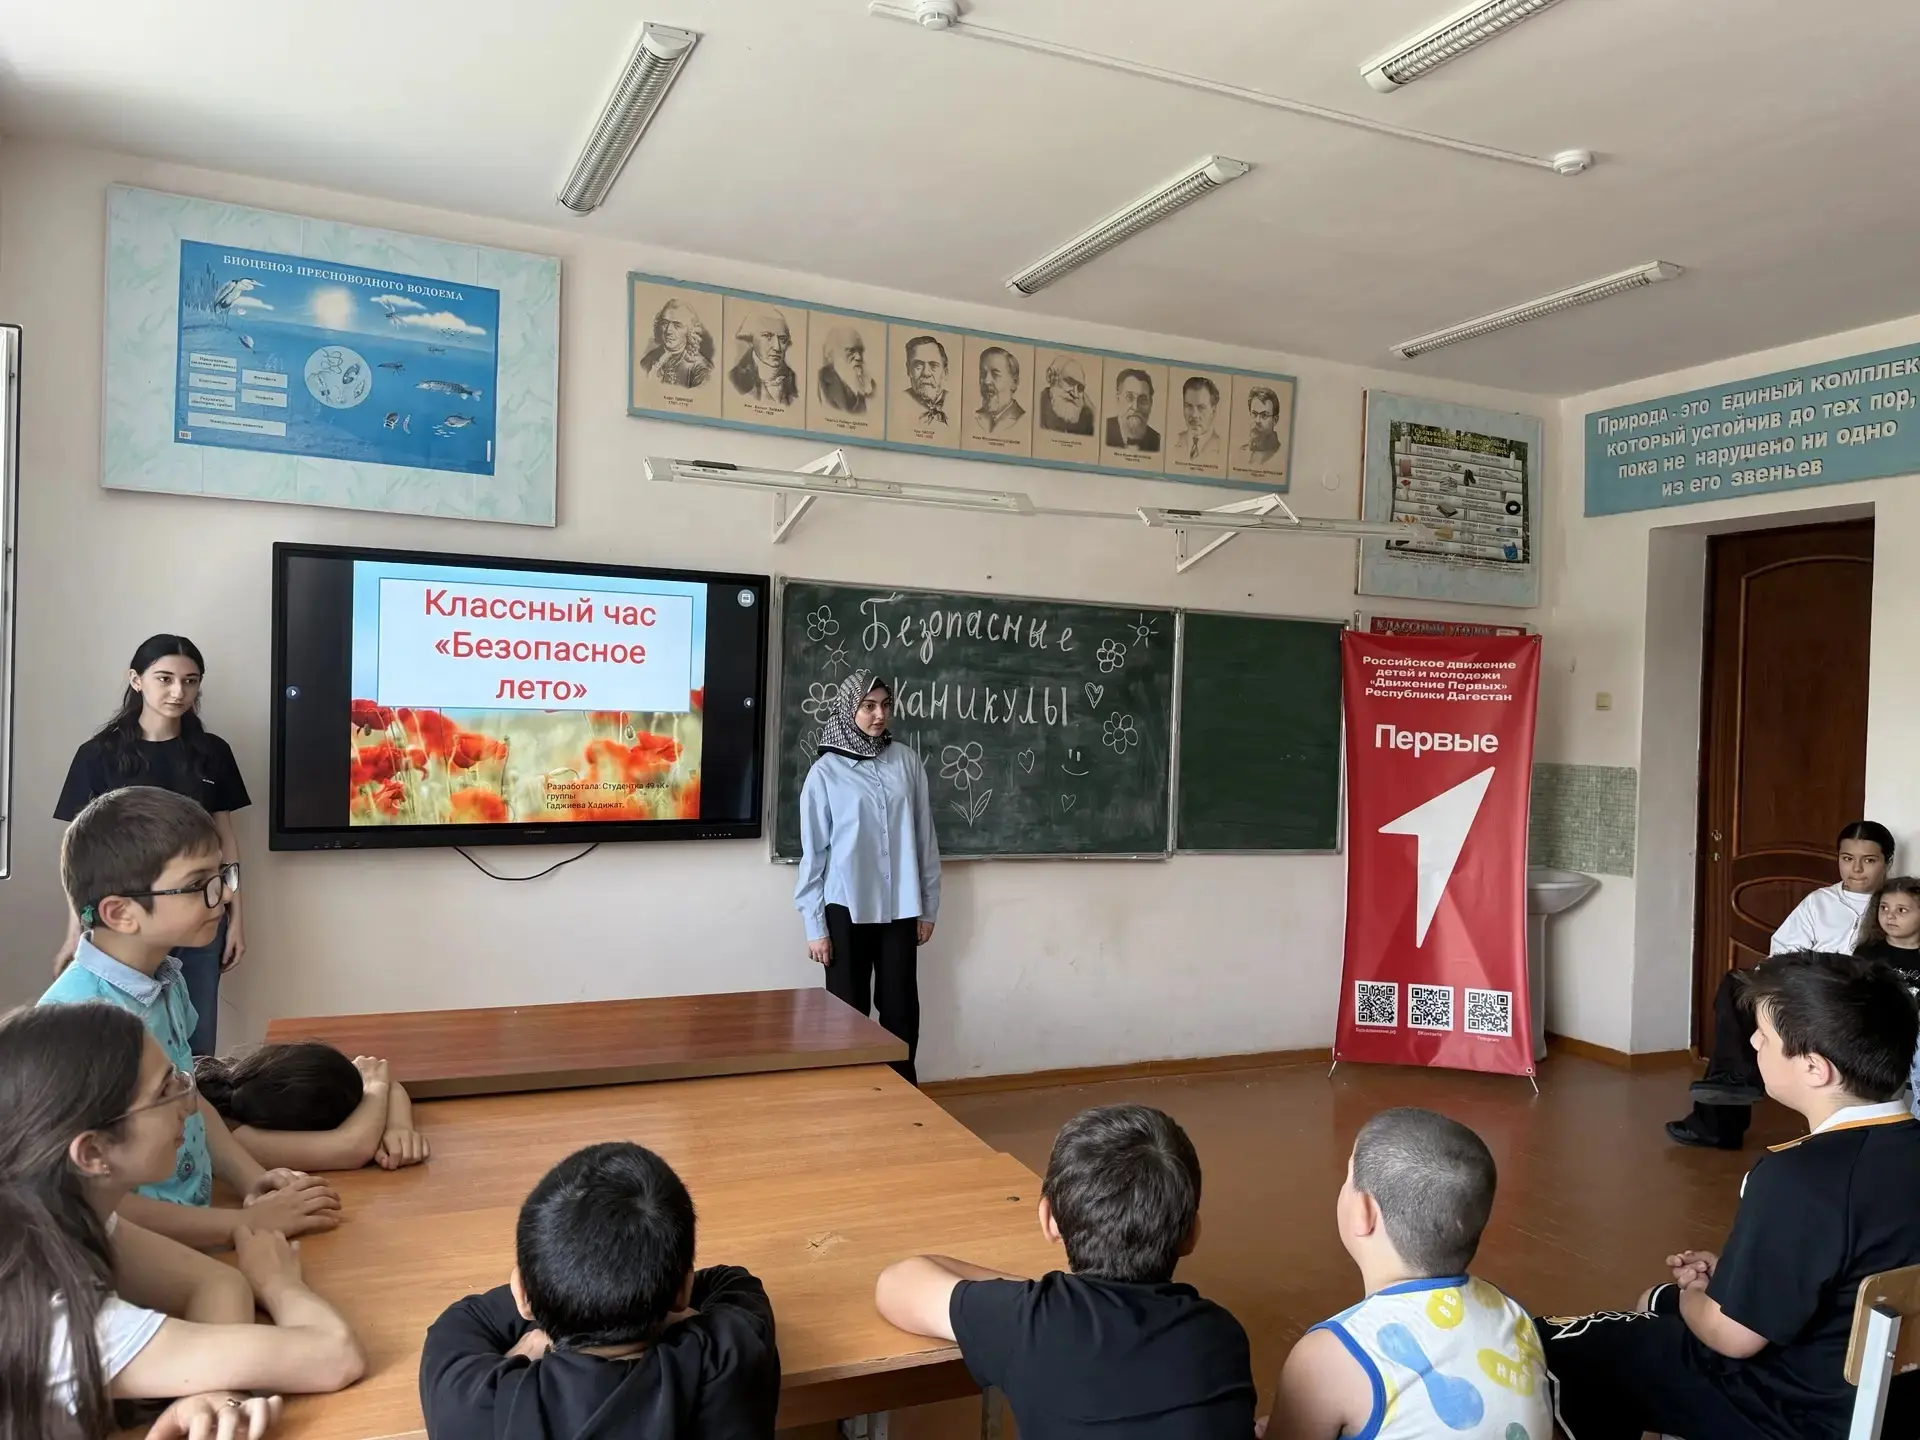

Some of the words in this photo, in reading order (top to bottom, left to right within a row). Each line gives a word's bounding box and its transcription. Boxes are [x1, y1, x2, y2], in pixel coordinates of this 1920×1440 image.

[223, 255, 293, 274] БИОЦЕНОЗ
[297, 266, 404, 291] ПРЕСНОВОДНОГО
[407, 284, 464, 301] ВОДОЕМА
[1811, 357, 1920, 393] КОМПЛЕК
[1691, 412, 1782, 446] устойчив
[1789, 406, 1816, 428] до
[1822, 398, 1861, 419] тех
[1870, 388, 1916, 412] пор,
[1619, 459, 1659, 479] пока
[1663, 454, 1686, 471] не
[1695, 436, 1796, 468] нарушено
[1801, 430, 1828, 450] ни
[1836, 420, 1897, 446] одно
[1661, 482, 1684, 498] из
[1690, 475, 1721, 493] его
[1731, 459, 1823, 486] звеньев
[424, 588, 594, 624] Классный
[603, 604, 657, 627] час
[860, 592, 1074, 664] Безопасные
[434, 632, 646, 664] «Безопасное
[1362, 655, 1445, 668] Российское
[1447, 660, 1517, 670] движение
[495, 677, 588, 700] лето»
[1369, 678, 1445, 689] «Движение
[1448, 681, 1508, 692] Первых»
[1375, 668, 1416, 678] детей
[1429, 671, 1501, 680] молодежи
[1365, 688, 1445, 700] Республики
[1447, 692, 1512, 702] Дагестан
[1375, 723, 1499, 758] Первые
[546, 783, 601, 791] Разработала:
[602, 782, 644, 790] Студентка
[546, 801, 586, 810] Гаджиева
[587, 801, 625, 809] Хадижат.
